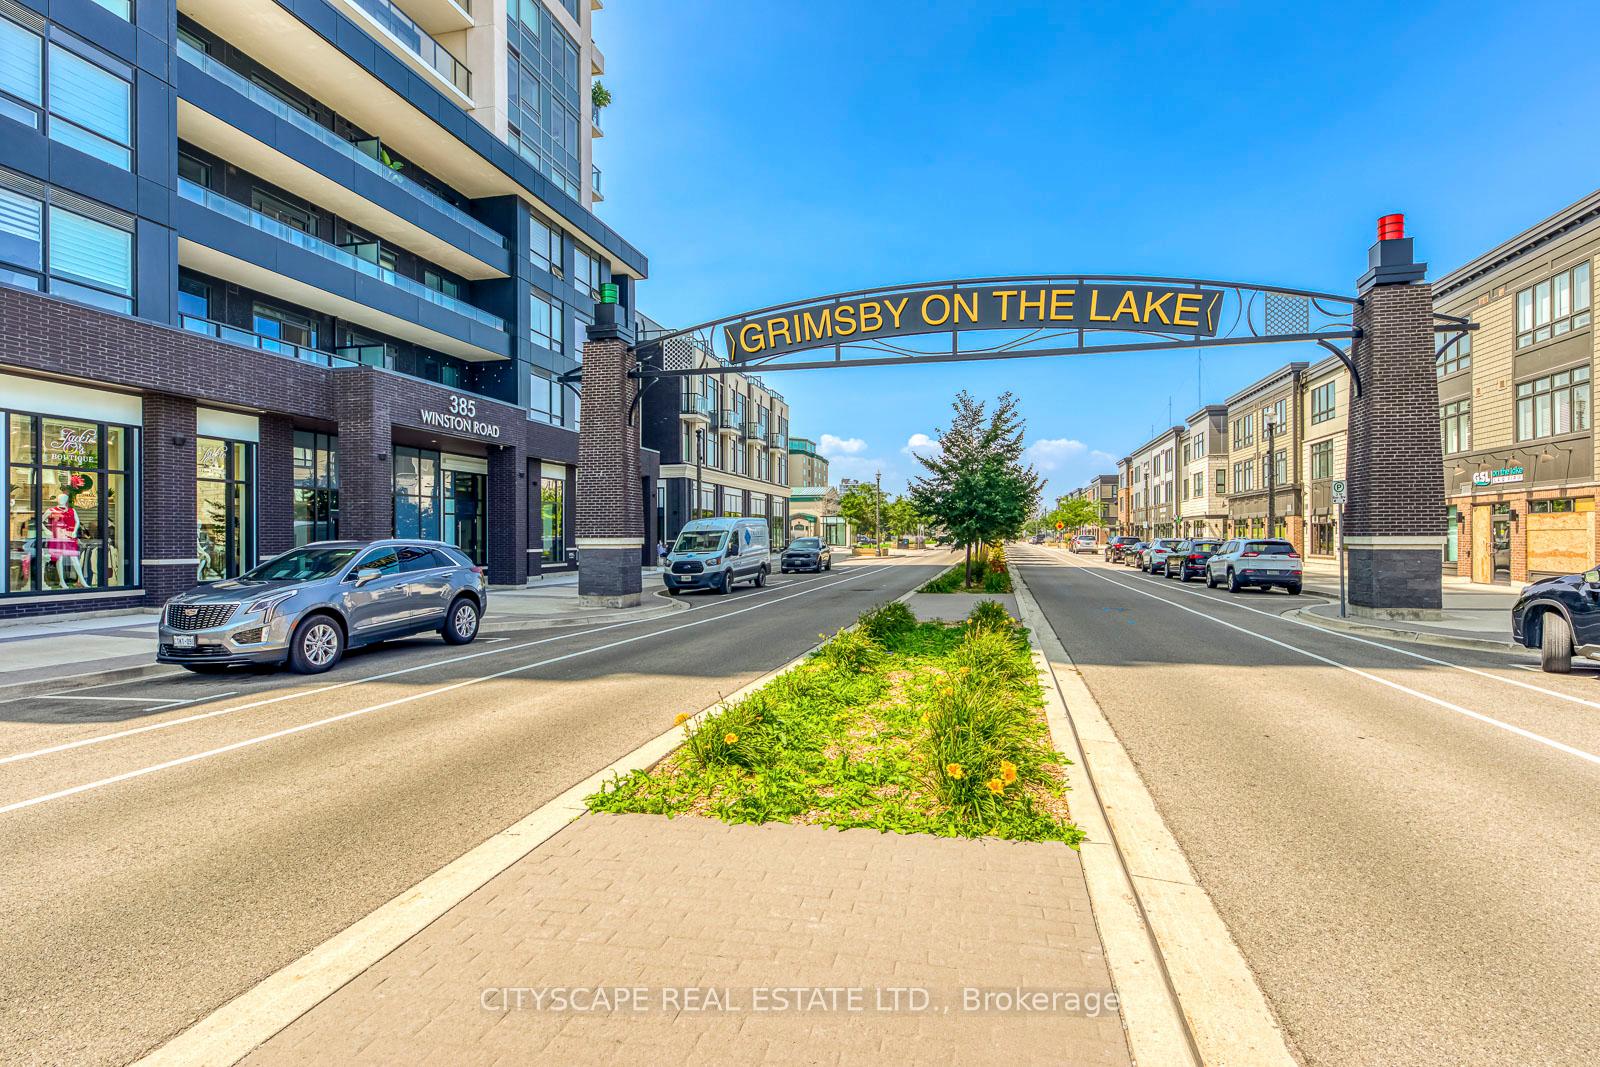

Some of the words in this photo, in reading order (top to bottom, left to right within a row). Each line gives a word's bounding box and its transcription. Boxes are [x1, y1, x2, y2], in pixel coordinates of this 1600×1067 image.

[739, 297, 909, 353] GRIMSBY
[921, 292, 979, 326] ON
[992, 289, 1076, 321] THE
[1089, 289, 1203, 327] LAKE
[449, 395, 476, 418] 385
[420, 409, 472, 433] WINSTON
[472, 421, 500, 438] ROAD
